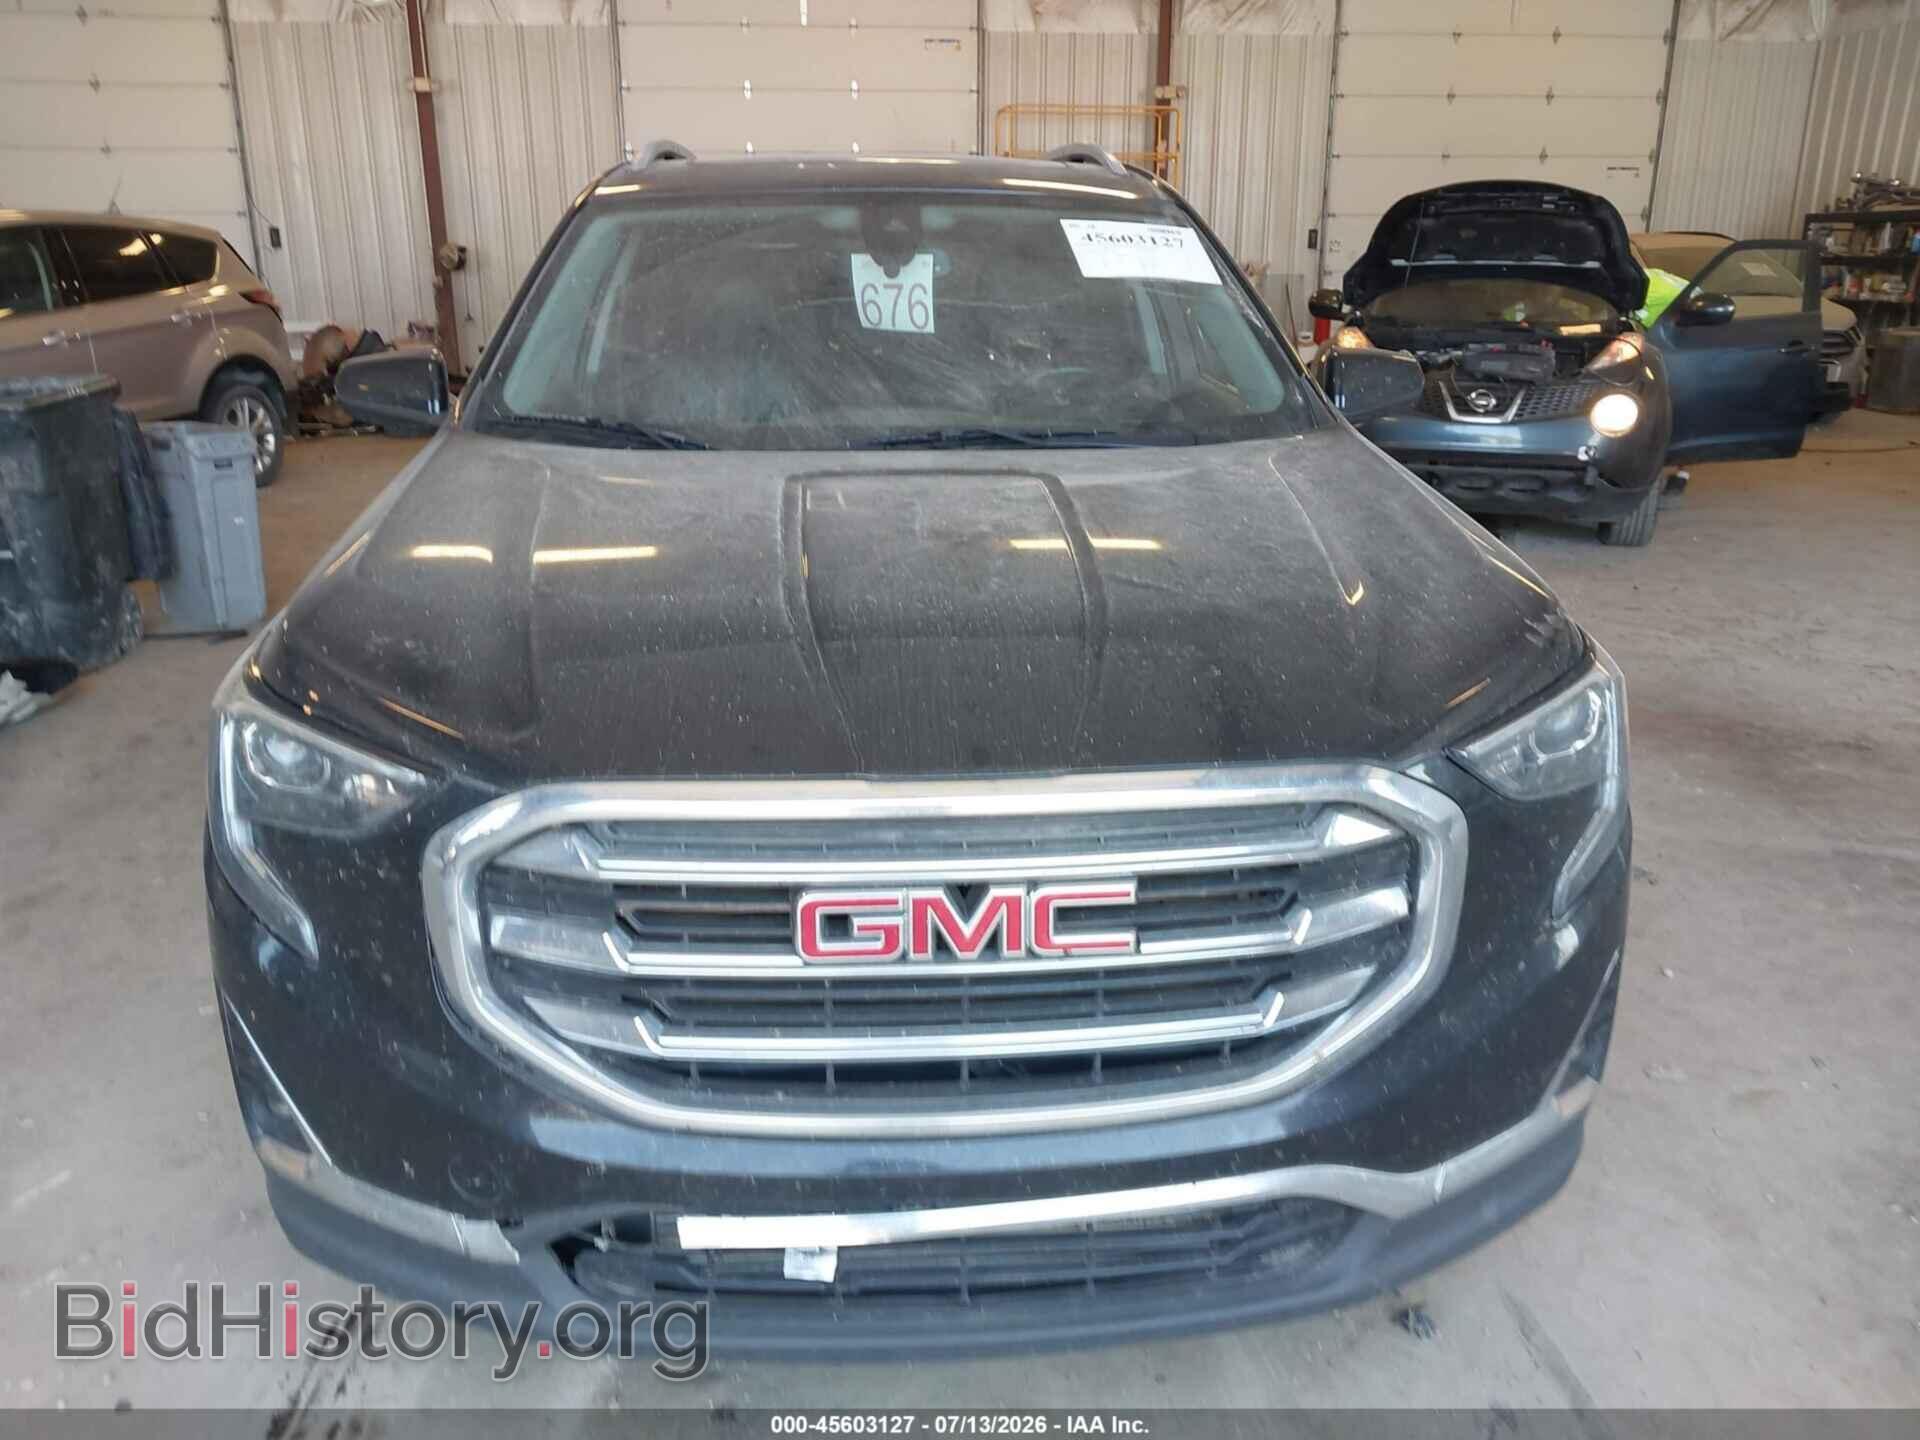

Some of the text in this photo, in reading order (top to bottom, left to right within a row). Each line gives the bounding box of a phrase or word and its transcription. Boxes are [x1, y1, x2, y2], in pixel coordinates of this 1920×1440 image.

[1081, 231, 1184, 249] 45603127
[860, 282, 930, 330] 676
[797, 881, 1137, 965] GMC
